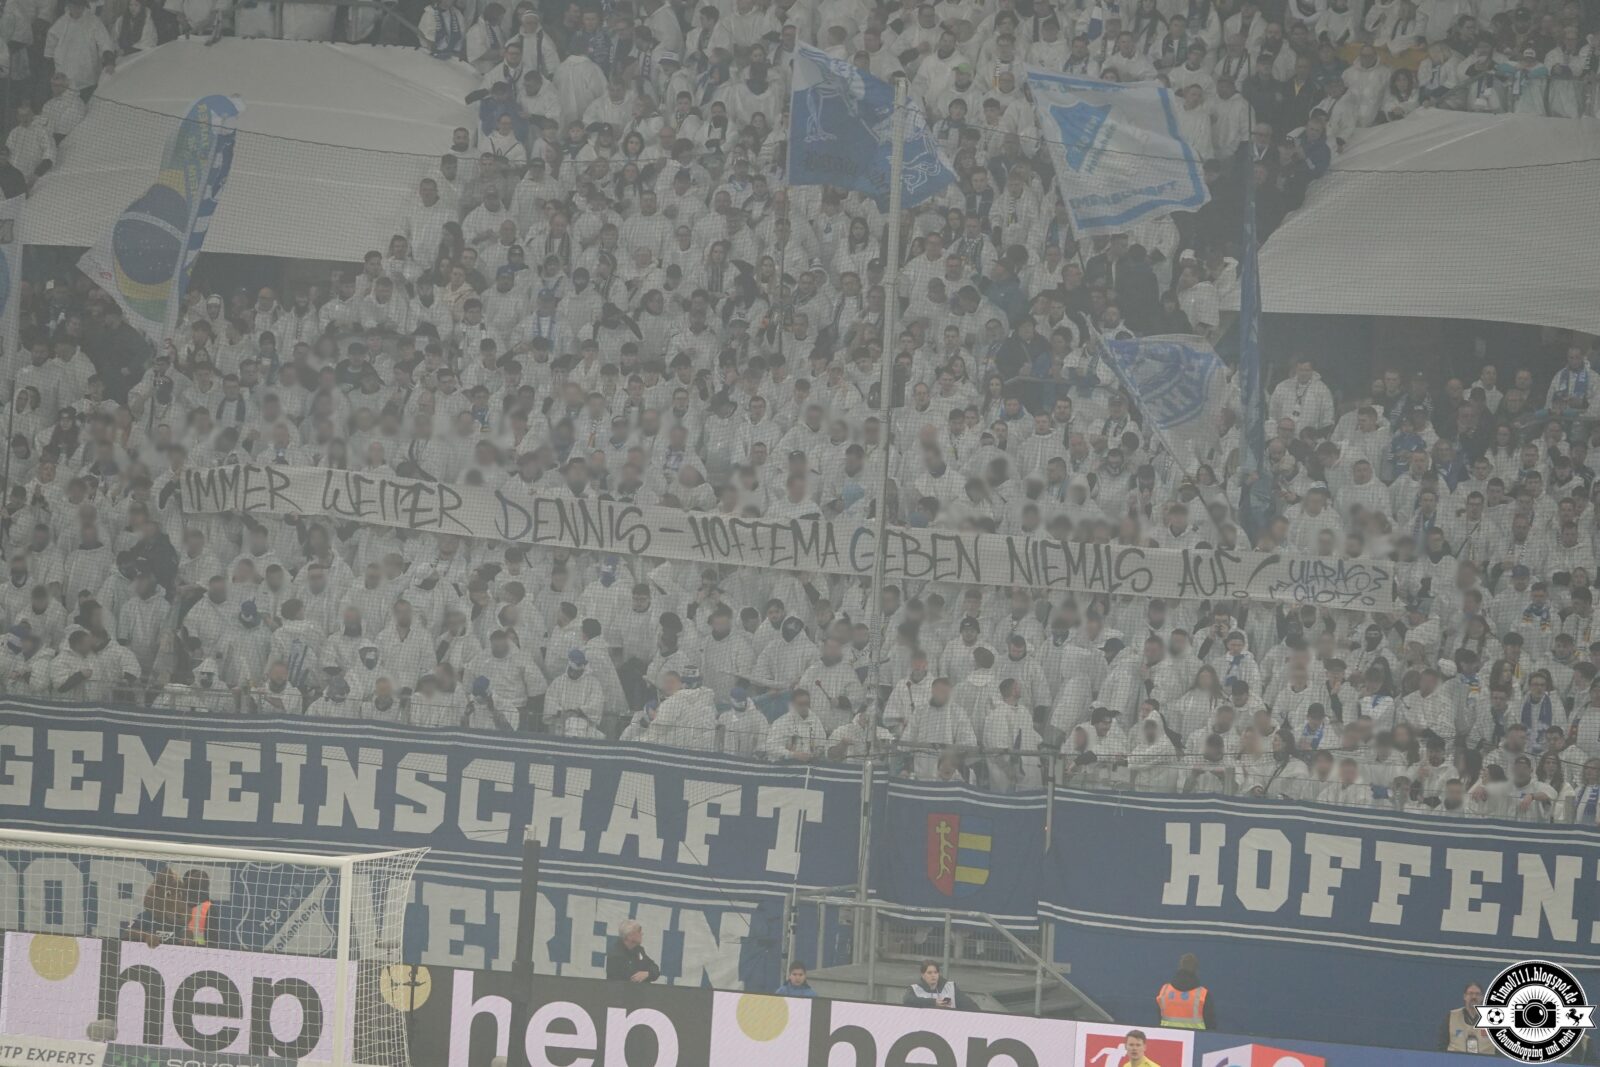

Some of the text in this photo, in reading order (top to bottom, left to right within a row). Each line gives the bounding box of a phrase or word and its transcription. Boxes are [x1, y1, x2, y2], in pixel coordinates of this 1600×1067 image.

[184, 464, 302, 512] IMMER
[321, 469, 474, 535] WEITER
[494, 489, 652, 554] DENNIS
[850, 526, 981, 582] GEBEN
[1006, 536, 1153, 593] NIEMALS
[0, 725, 824, 874] GEMEINSCHAFT
[1162, 822, 1600, 943] HOFFEN
[0, 1045, 96, 1066] TP EXPERTS
[101, 937, 323, 1059] hep
[449, 970, 679, 1067] hep
